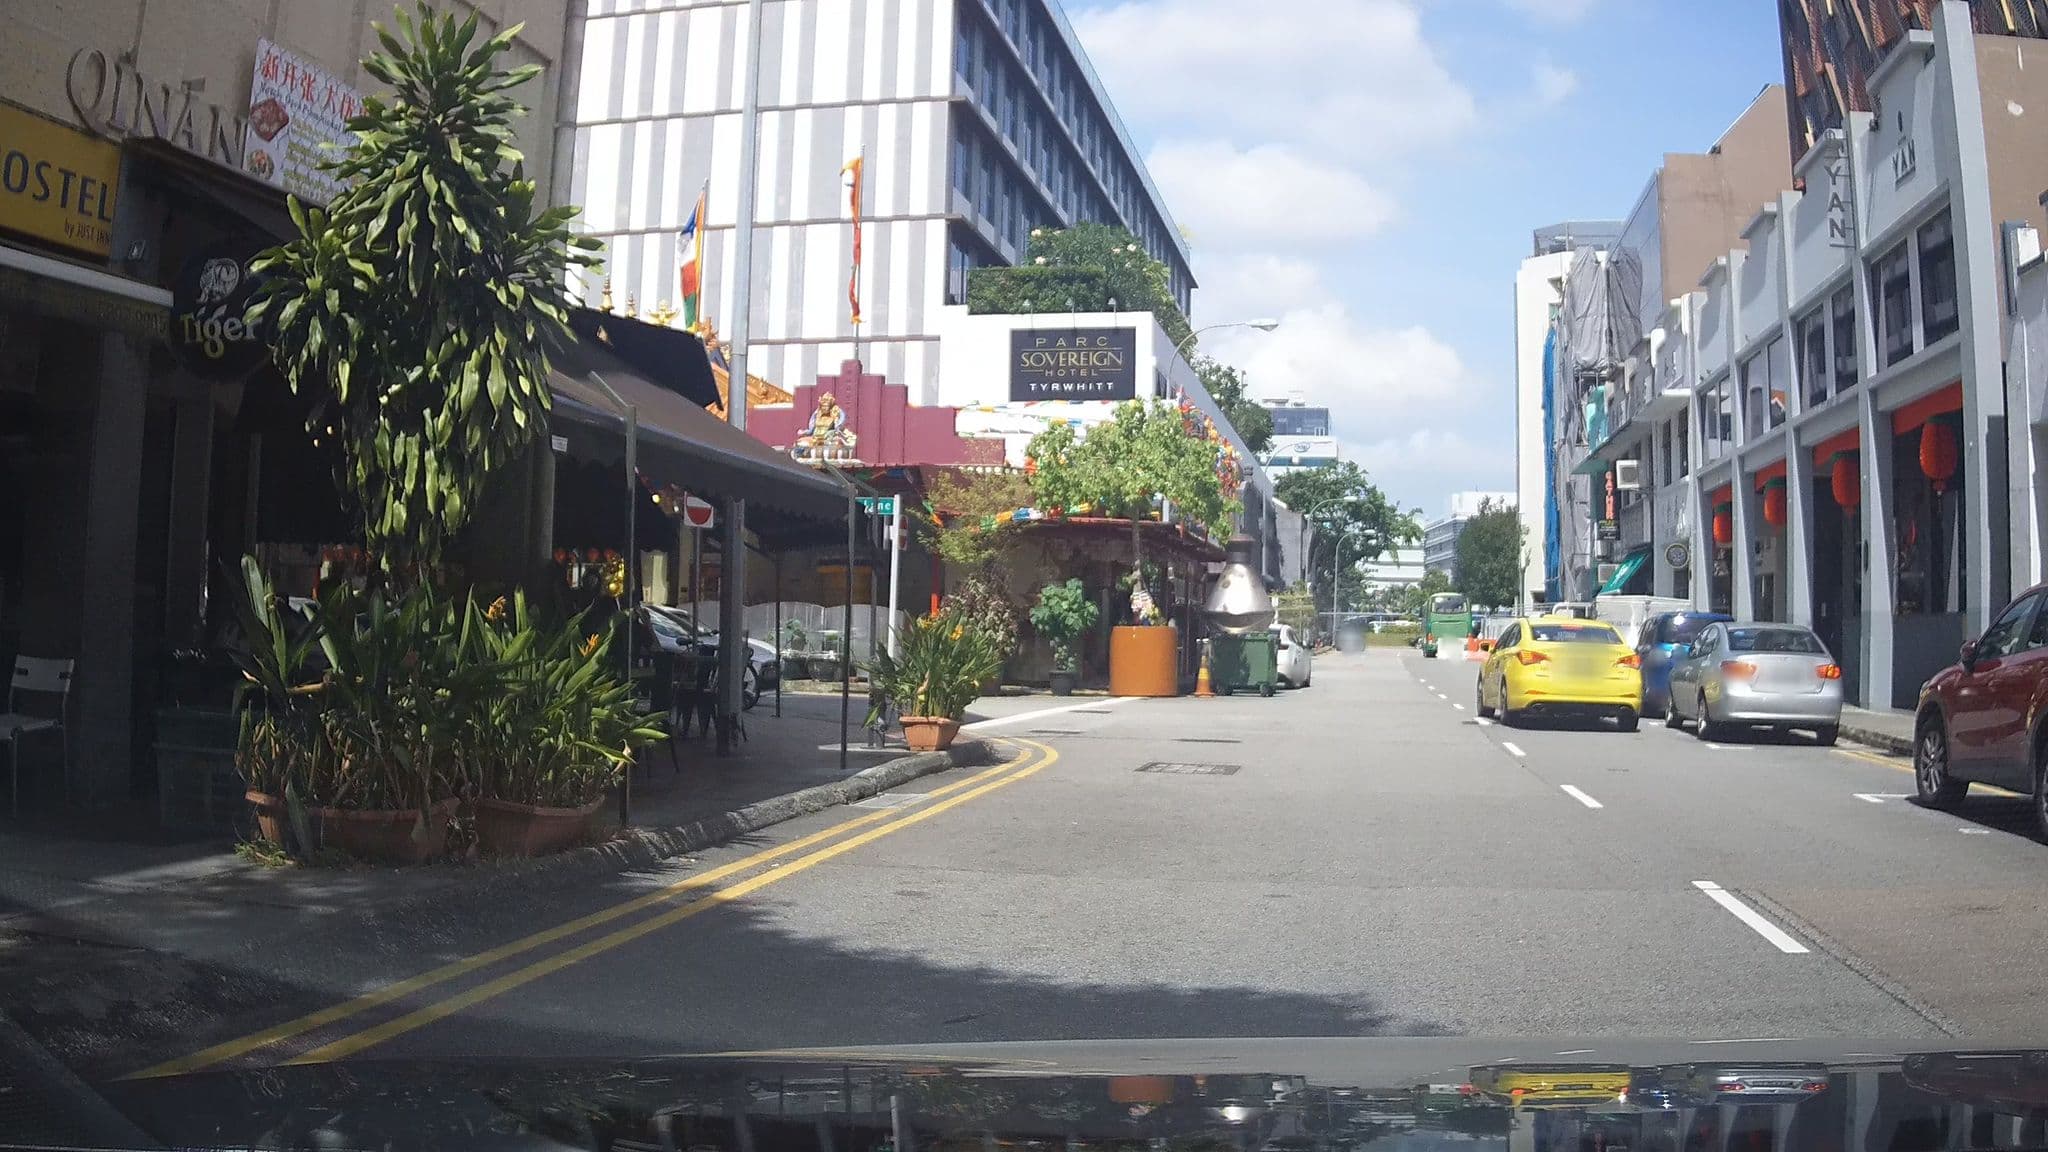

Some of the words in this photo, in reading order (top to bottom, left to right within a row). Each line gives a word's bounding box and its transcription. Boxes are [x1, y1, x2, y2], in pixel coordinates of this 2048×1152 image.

[1893, 138, 1915, 178] YAN
[1824, 165, 1846, 238] YAN
[181, 304, 263, 358] Tiger
[1036, 337, 1108, 347] PARC
[1021, 351, 1123, 367] SOVEREIGN
[1045, 368, 1098, 376] HOTEL
[1030, 382, 1113, 391] TYRWHITT
